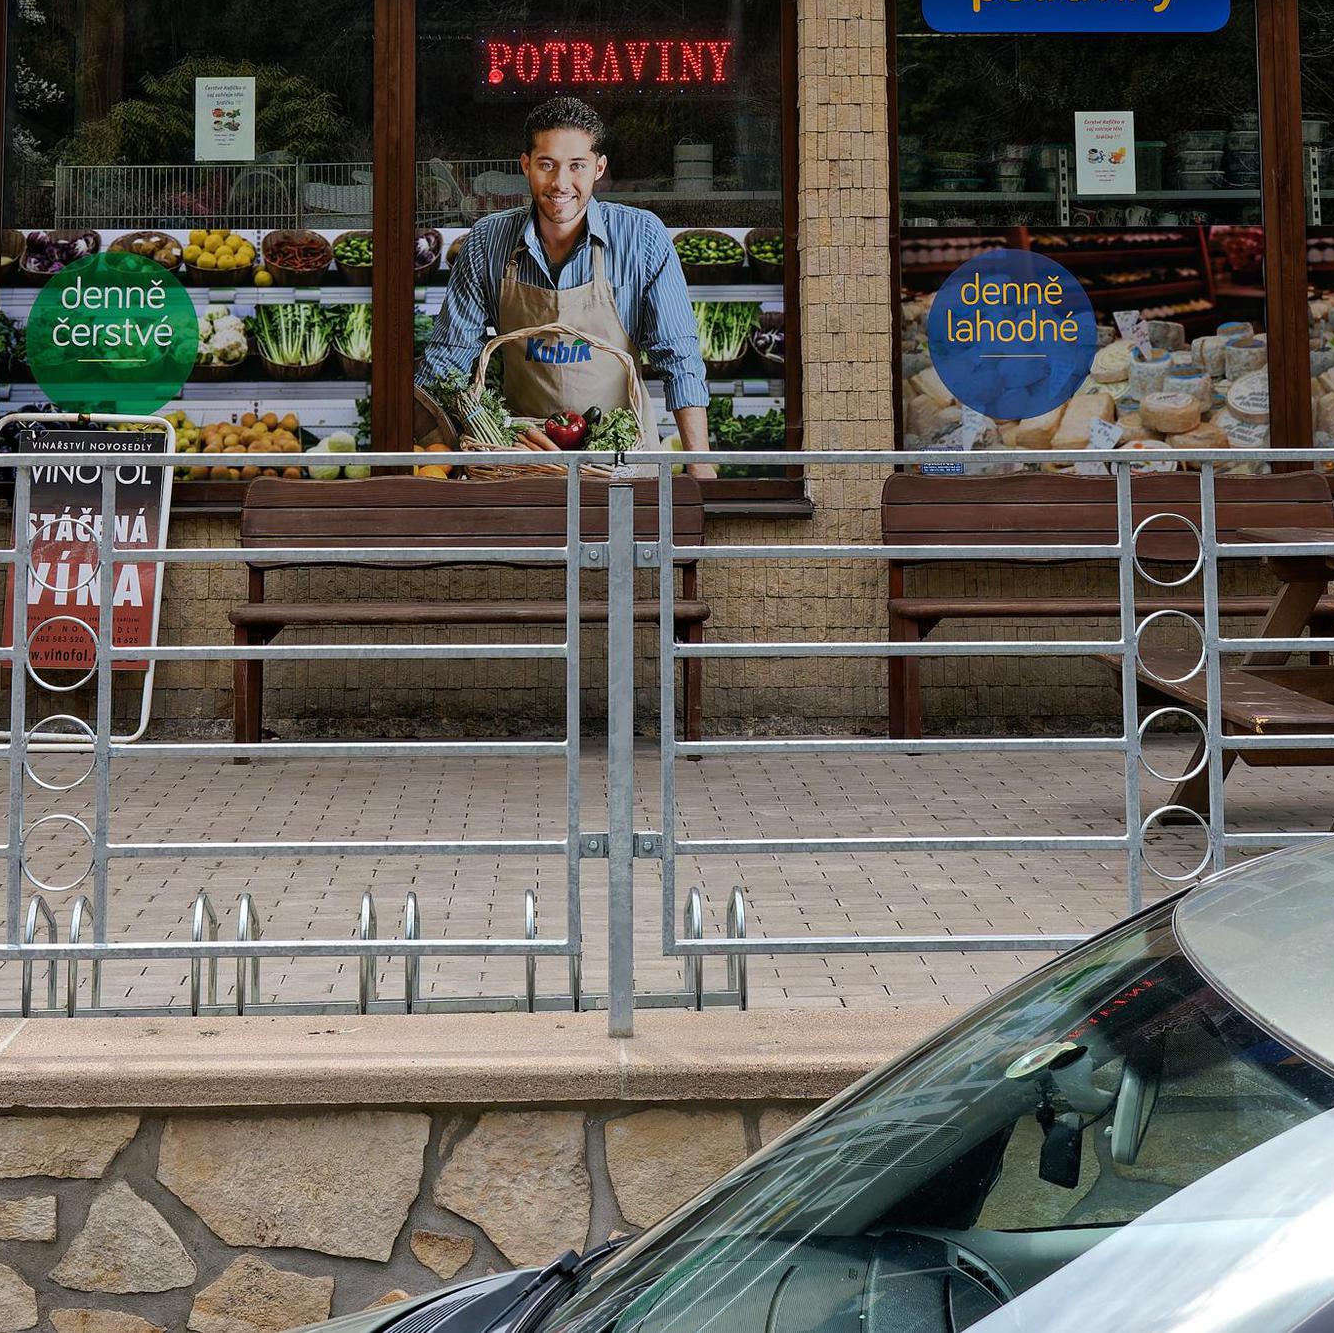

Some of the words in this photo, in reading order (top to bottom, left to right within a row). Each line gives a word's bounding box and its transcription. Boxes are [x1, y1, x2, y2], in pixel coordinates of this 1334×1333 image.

[489, 42, 731, 82] POTRAVINY
[61, 275, 166, 309] denně
[960, 272, 1063, 305] denně
[52, 315, 173, 347] čerstvé
[947, 309, 1079, 342] lahodné
[32, 441, 85, 451] VINAŘSTVÍ
[89, 442, 153, 452] NOVOSEDLY
[32, 465, 152, 485] VINOOL
[27, 551, 143, 607] VÍNA
